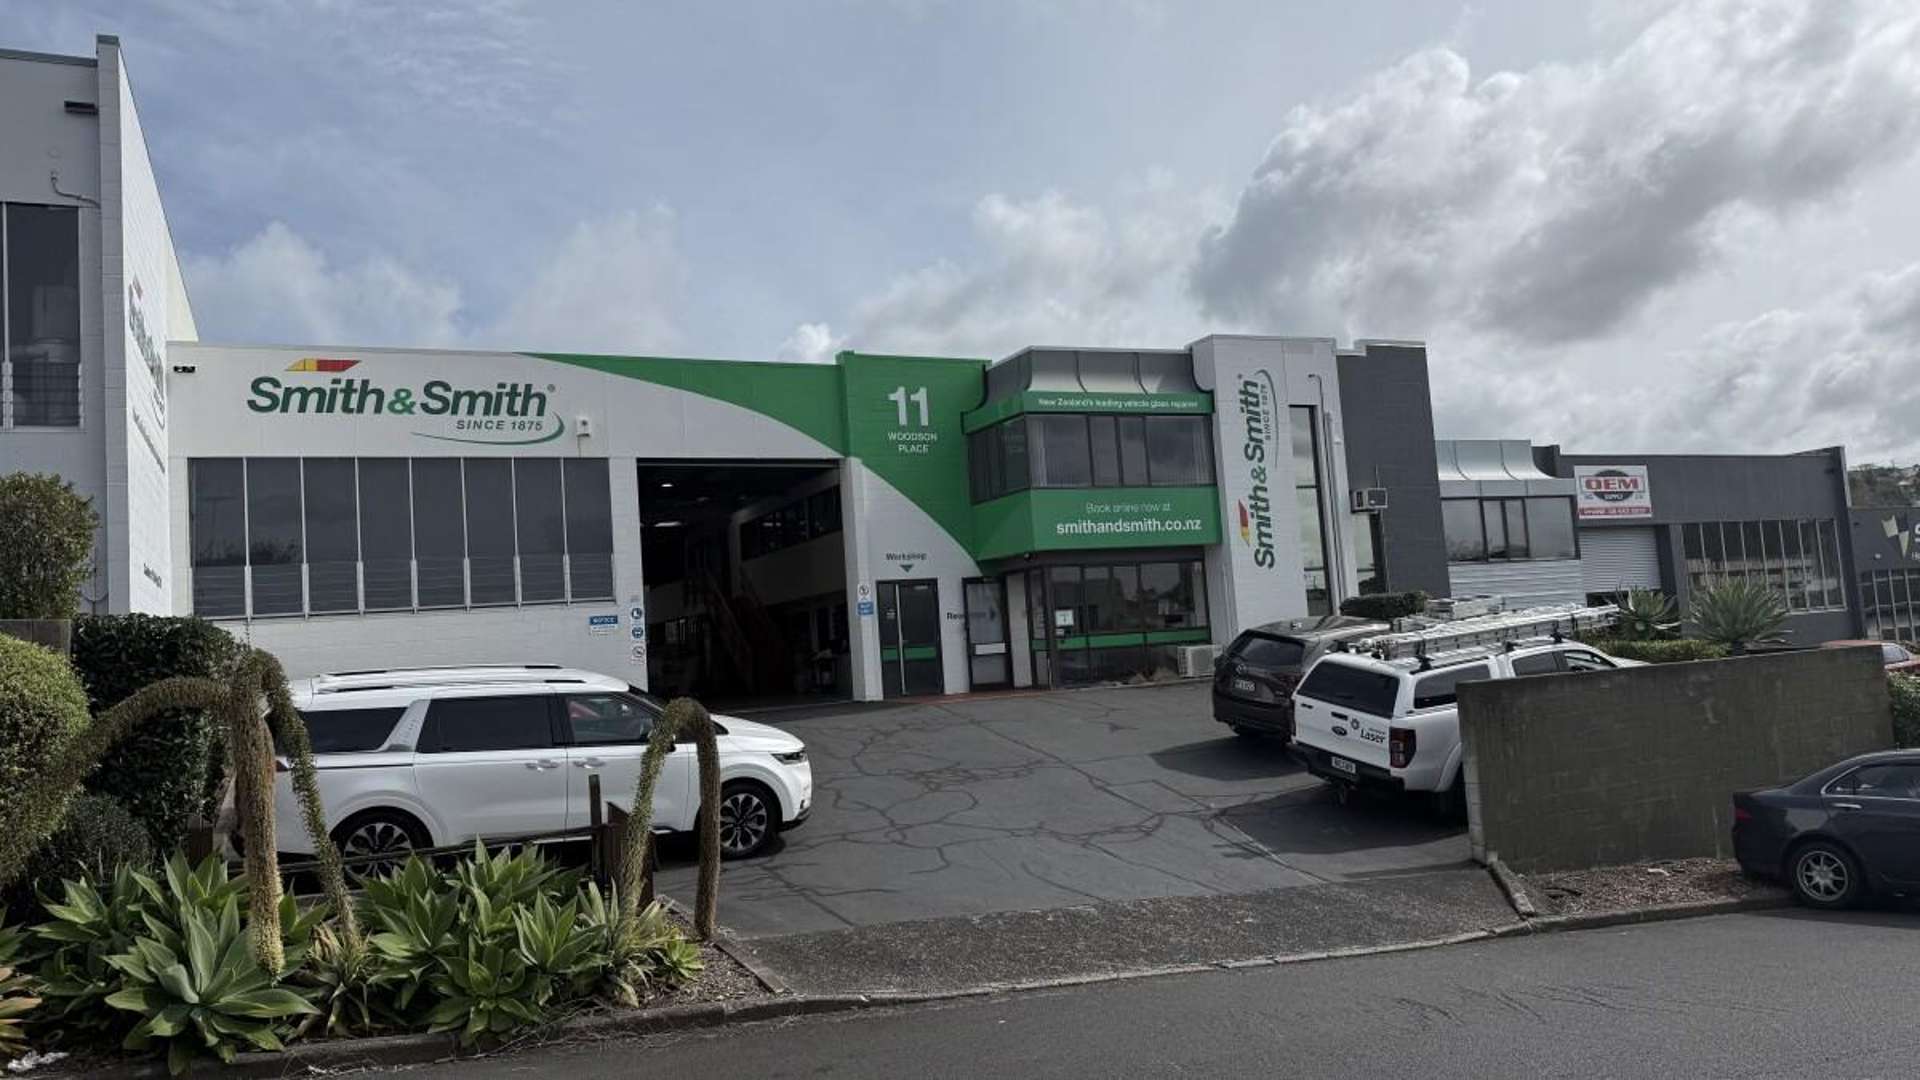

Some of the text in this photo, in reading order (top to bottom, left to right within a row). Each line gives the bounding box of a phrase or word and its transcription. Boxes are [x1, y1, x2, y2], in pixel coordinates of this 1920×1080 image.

[887, 386, 929, 426] 11
[456, 419, 543, 431] SINCE 1875
[1263, 411, 1271, 440] SINCE
[888, 432, 938, 441] WOODSON
[898, 444, 929, 453] PLACE
[1585, 478, 1639, 491] OEM
[1056, 518, 1202, 534] smithandsmith.co.nz
[1360, 728, 1386, 743] Laser
